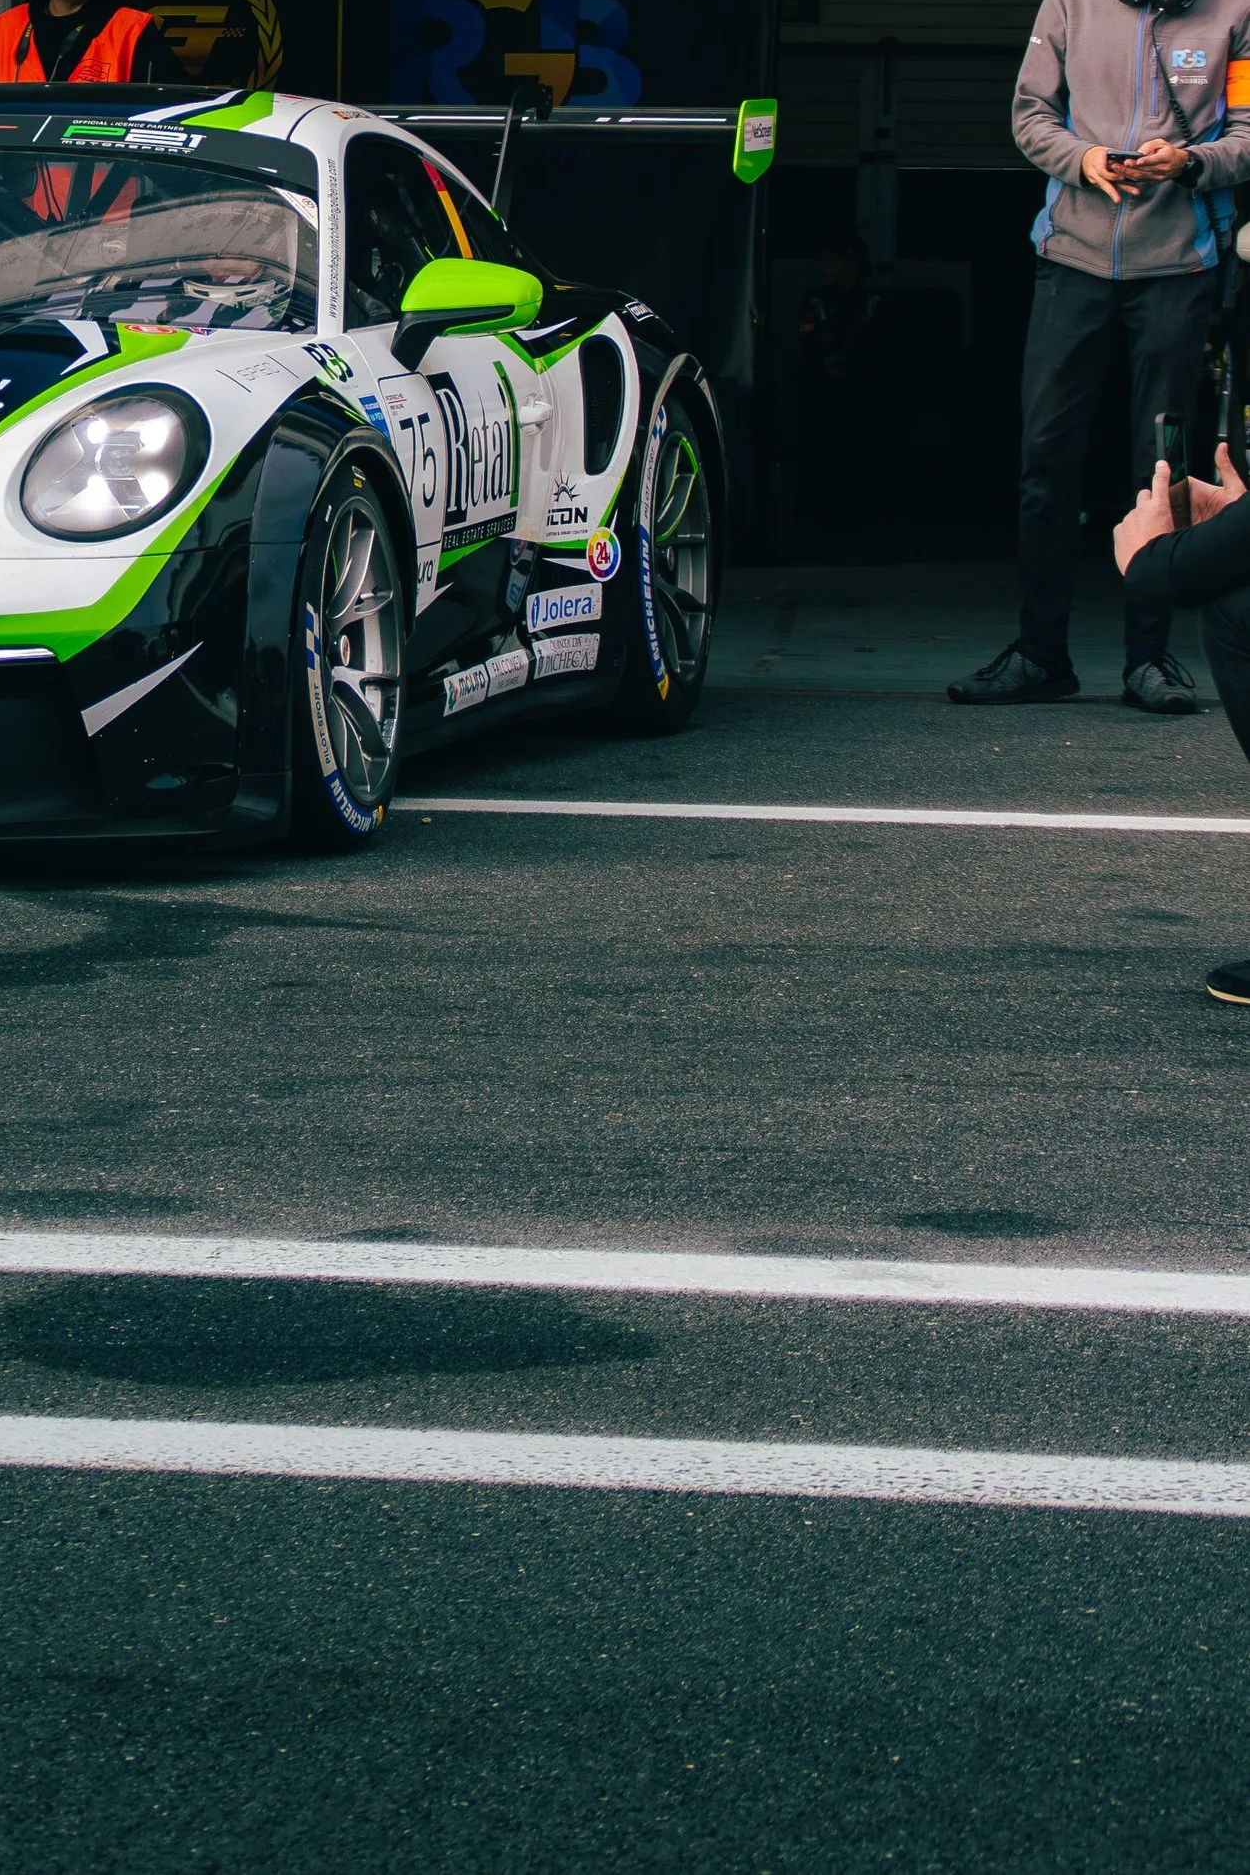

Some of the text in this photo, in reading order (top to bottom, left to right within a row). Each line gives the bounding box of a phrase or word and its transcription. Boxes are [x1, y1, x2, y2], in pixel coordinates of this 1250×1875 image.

[72, 119, 108, 127] OFFICIAL
[61, 140, 195, 153] MOTORSPORT
[327, 158, 340, 318] www.porschesprintchallengeiberica.com
[399, 412, 437, 508] 75
[444, 516, 515, 549] REAL ESTATE SERVICES
[418, 559, 434, 585] uro
[542, 595, 592, 623] Jolera
[642, 538, 660, 662] MICHELIN
[314, 684, 332, 766] PILOT SPORT
[330, 777, 370, 832] MICHELIN
